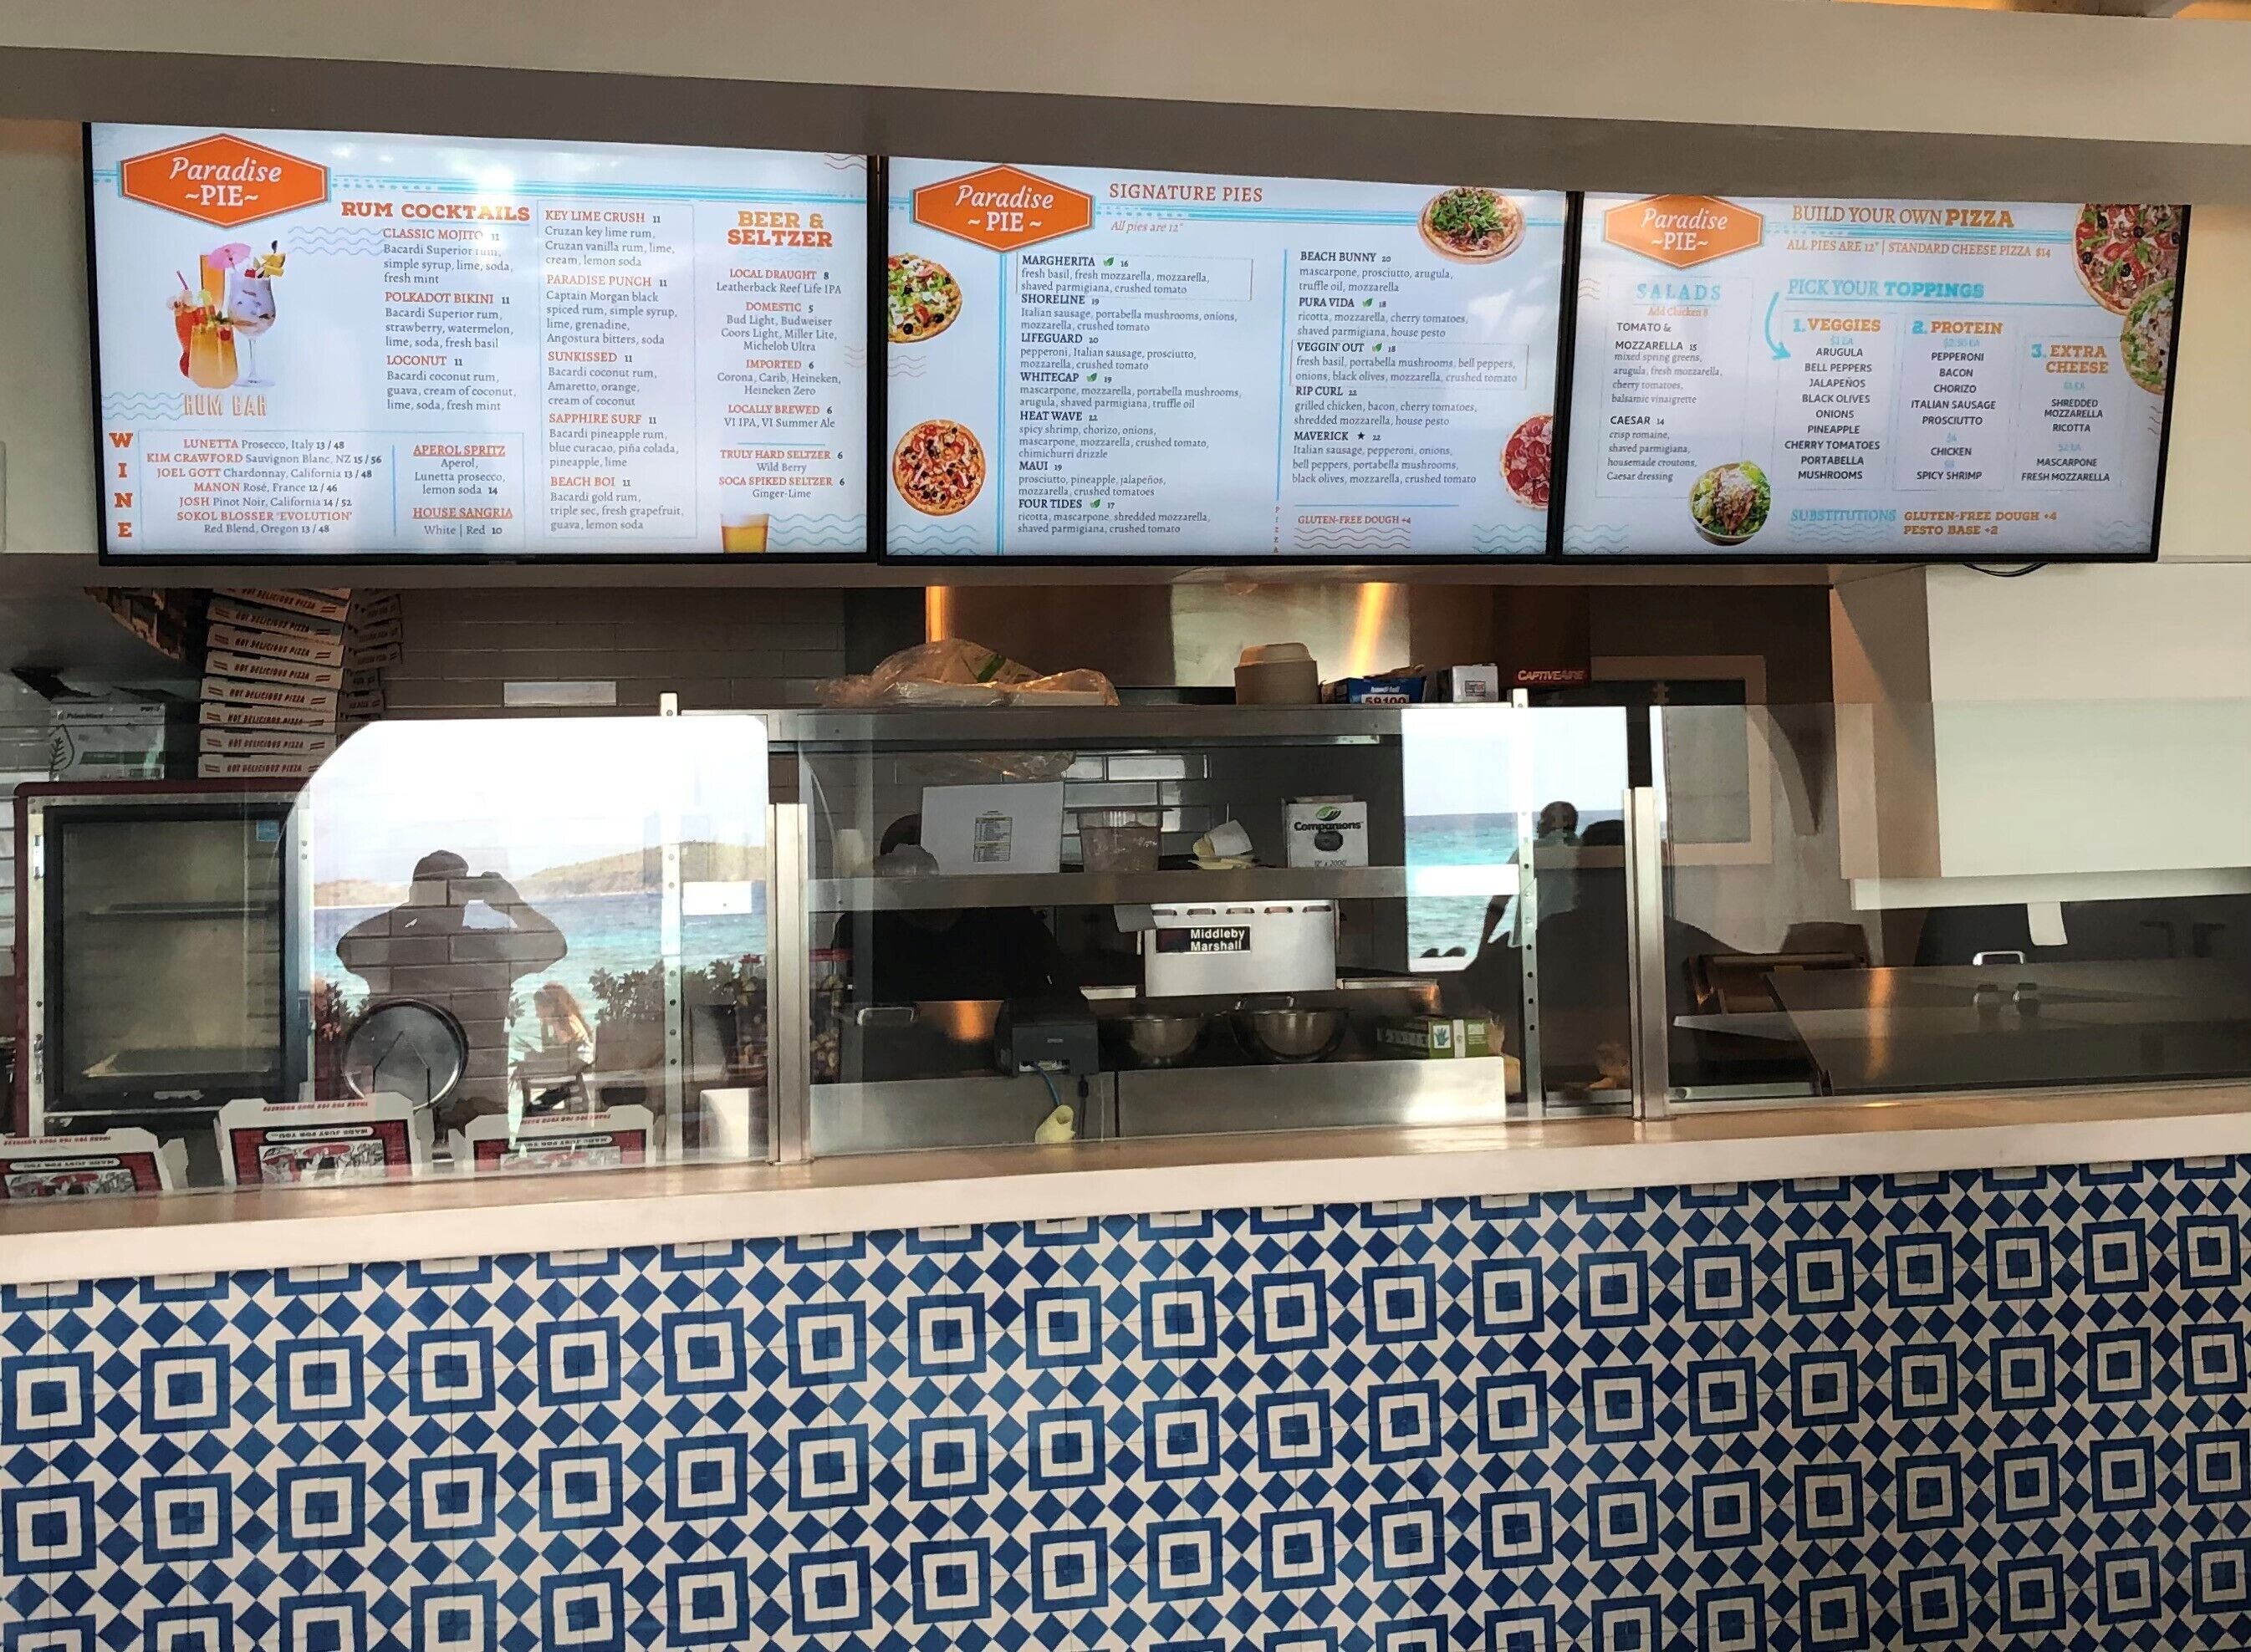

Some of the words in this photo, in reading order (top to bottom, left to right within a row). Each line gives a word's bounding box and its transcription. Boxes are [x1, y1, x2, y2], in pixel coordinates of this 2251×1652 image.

[171, 157, 282, 182] Paradise
[955, 185, 1054, 209] Paradise
[1110, 183, 1217, 201] SIGNATURE
[1223, 187, 1263, 202] PIES
[341, 201, 393, 217] RUM
[401, 203, 530, 221] COCKTAILS
[546, 211, 568, 221] KEY
[571, 212, 600, 222] LIME
[604, 212, 645, 222] CRUSH
[738, 212, 800, 227] BEER
[809, 213, 824, 228] &
[1641, 208, 1728, 229] Paradise
[1793, 206, 1845, 222] BUILD
[1849, 207, 1896, 223] YOUR
[1900, 209, 1941, 225] OWN
[1946, 209, 2014, 227] PIZZA
[986, 212, 1023, 232] PIE
[1111, 220, 1124, 232] All
[1126, 222, 1147, 234] pies
[1150, 223, 1166, 232] are
[727, 229, 833, 247] SELTZER
[1022, 256, 1095, 267] MARGHERITA
[1300, 252, 1336, 262] BEACH
[1340, 252, 1376, 263] BUNNY
[730, 269, 763, 278] LOCAL
[766, 270, 817, 279] DRAUGHT
[1022, 269, 1045, 278] fresh
[1048, 271, 1072, 279] basil,
[1075, 270, 1098, 279] fresh
[1101, 272, 1154, 282] mozzarella,
[1156, 273, 1210, 283] mozzarella,
[1636, 284, 1721, 300] SALADS
[1788, 279, 1826, 295] PICK
[1830, 280, 1878, 296] YOUR
[1885, 282, 1983, 298] TOPPINGS
[385, 293, 451, 303] POLKADOT
[454, 293, 493, 303] BIKINI
[546, 291, 586, 303] Captain
[590, 292, 629, 303] Morgan
[632, 293, 658, 302] black
[1022, 294, 1085, 304] SHORELINE
[746, 302, 801, 312] DOMESTIC
[385, 324, 445, 334] strawberry,
[448, 326, 513, 334] watermelon,
[1617, 323, 1661, 332] TOMATO
[1794, 319, 1805, 332] 1.
[1808, 319, 1881, 332] VEGGIES
[1912, 321, 1927, 334] 2.
[1931, 321, 2002, 334] PROTEIN
[1022, 334, 1082, 343] LIFEGUARD
[744, 341, 789, 350] Michelob
[792, 342, 815, 351] Ultra
[1298, 343, 1340, 352] VEGGIN'
[1343, 343, 1364, 352] OUT
[1616, 341, 1682, 350] MOZZARELLA
[1816, 348, 1863, 357] ARUGULA
[2031, 344, 2046, 358] 3.
[2050, 344, 2106, 358] EXTRA
[387, 355, 447, 365] LOCONUT
[1931, 352, 1984, 361] PEPPERONI
[746, 359, 801, 369] IMPORTED
[1804, 364, 1827, 372] BELL
[1830, 364, 1872, 372] PEPPERS
[2046, 361, 2108, 374] CHEESE
[1939, 369, 1973, 377] BACON
[1809, 377, 1866, 387] JALAPEÑOS
[1933, 385, 1977, 393] CHORIZO
[1802, 395, 1834, 403] BLACK
[1836, 395, 1870, 403] OLIVES
[2051, 399, 2098, 407] SHREDDED
[1912, 400, 1949, 409] ITALIAN
[1952, 401, 1996, 410] SAUSAGE
[1020, 411, 1049, 421] HEAT
[1052, 412, 1082, 421] WAVE
[1815, 410, 1854, 419] ONIONS
[2044, 410, 2103, 418] MOZZARELLA
[1610, 416, 1651, 425] CAESAR
[1922, 416, 1983, 425] PROSCIUTTO
[1808, 426, 1860, 434] PINEAPPLE
[1294, 431, 1348, 441] MAVERICK
[1784, 441, 1824, 449] CHERRY
[413, 446, 462, 456] APEROL
[464, 446, 506, 456] SPRITZ
[1931, 447, 1972, 456] CHICKEN
[1019, 461, 1049, 470] MAUI
[1801, 456, 1864, 465] PORTABELLA
[2037, 458, 2097, 467] MASCARPONE
[757, 463, 778, 472] Wild
[782, 463, 806, 473] Berry
[1798, 471, 1863, 479] MUSHROOMS
[1917, 472, 1944, 480] SPICY
[2051, 473, 2110, 482] MOZZARELLA
[551, 477, 590, 487] BEACH
[595, 477, 615, 487] BOI
[753, 490, 811, 499] Ginger-Lime
[1018, 500, 1048, 508] FOUR
[1051, 500, 1082, 508] TIDES
[412, 507, 456, 518] HOUSE
[460, 508, 513, 518] SANGRIA
[1905, 512, 1991, 521] GLUTEN-FREE
[1996, 512, 2039, 521] DOUGH
[1904, 525, 1943, 535] PESTO
[1947, 526, 1981, 535] BASE
[235, 638, 248, 646] HOT
[250, 640, 288, 653] DELICIOUS
[289, 648, 309, 656] PIZZA
[230, 688, 242, 697] HOT
[245, 690, 283, 701] DELICIOUS
[284, 693, 305, 703] PIZZA
[1294, 822, 1361, 834] Companions
[1191, 929, 1245, 941] Middleby
[1191, 941, 1241, 951] Marshall
